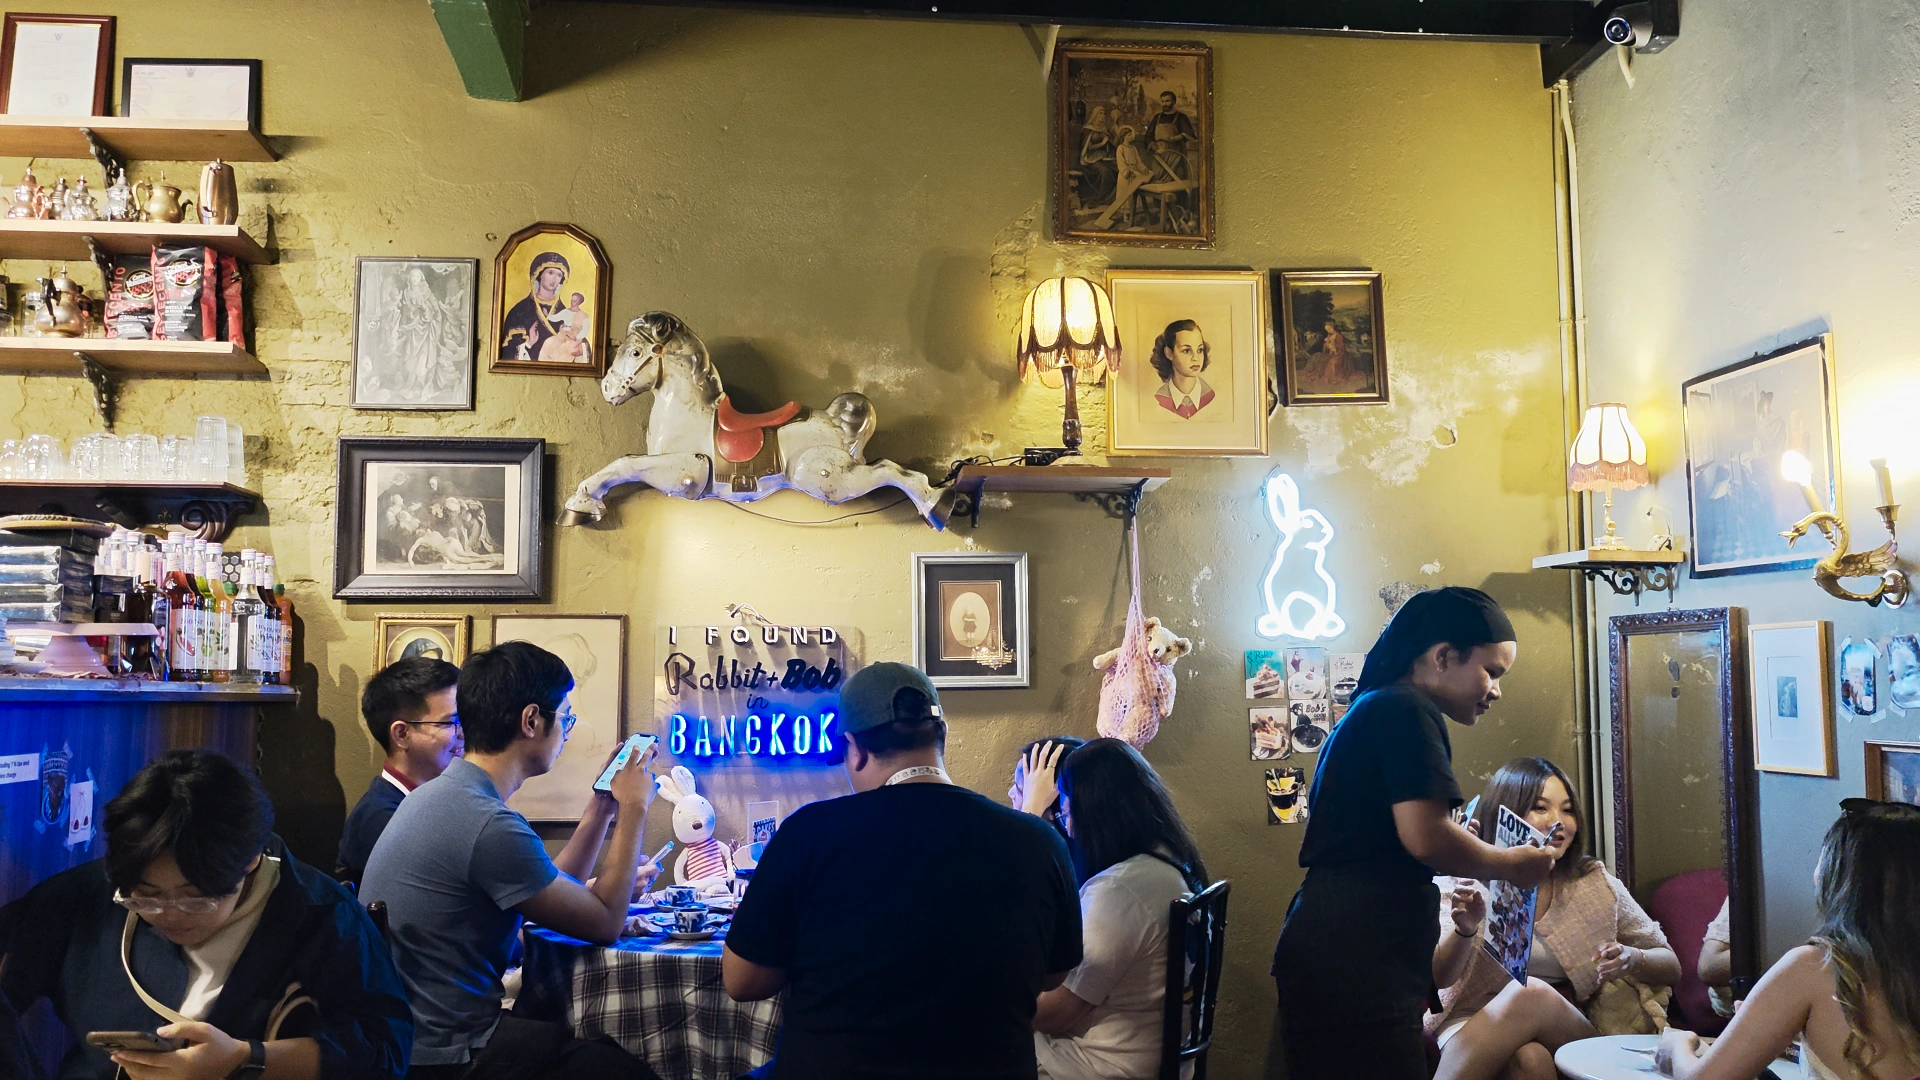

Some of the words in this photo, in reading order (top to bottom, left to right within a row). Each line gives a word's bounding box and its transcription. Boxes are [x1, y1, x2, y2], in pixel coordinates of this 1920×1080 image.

[669, 625, 678, 645] I
[705, 625, 838, 646] FOUND
[664, 652, 767, 695] Rabbit
[780, 657, 842, 691] Bob
[746, 693, 770, 710] in
[1305, 703, 1327, 713] Bob's
[669, 712, 837, 757] BANGKOK
[1499, 808, 1531, 841] LOVE
